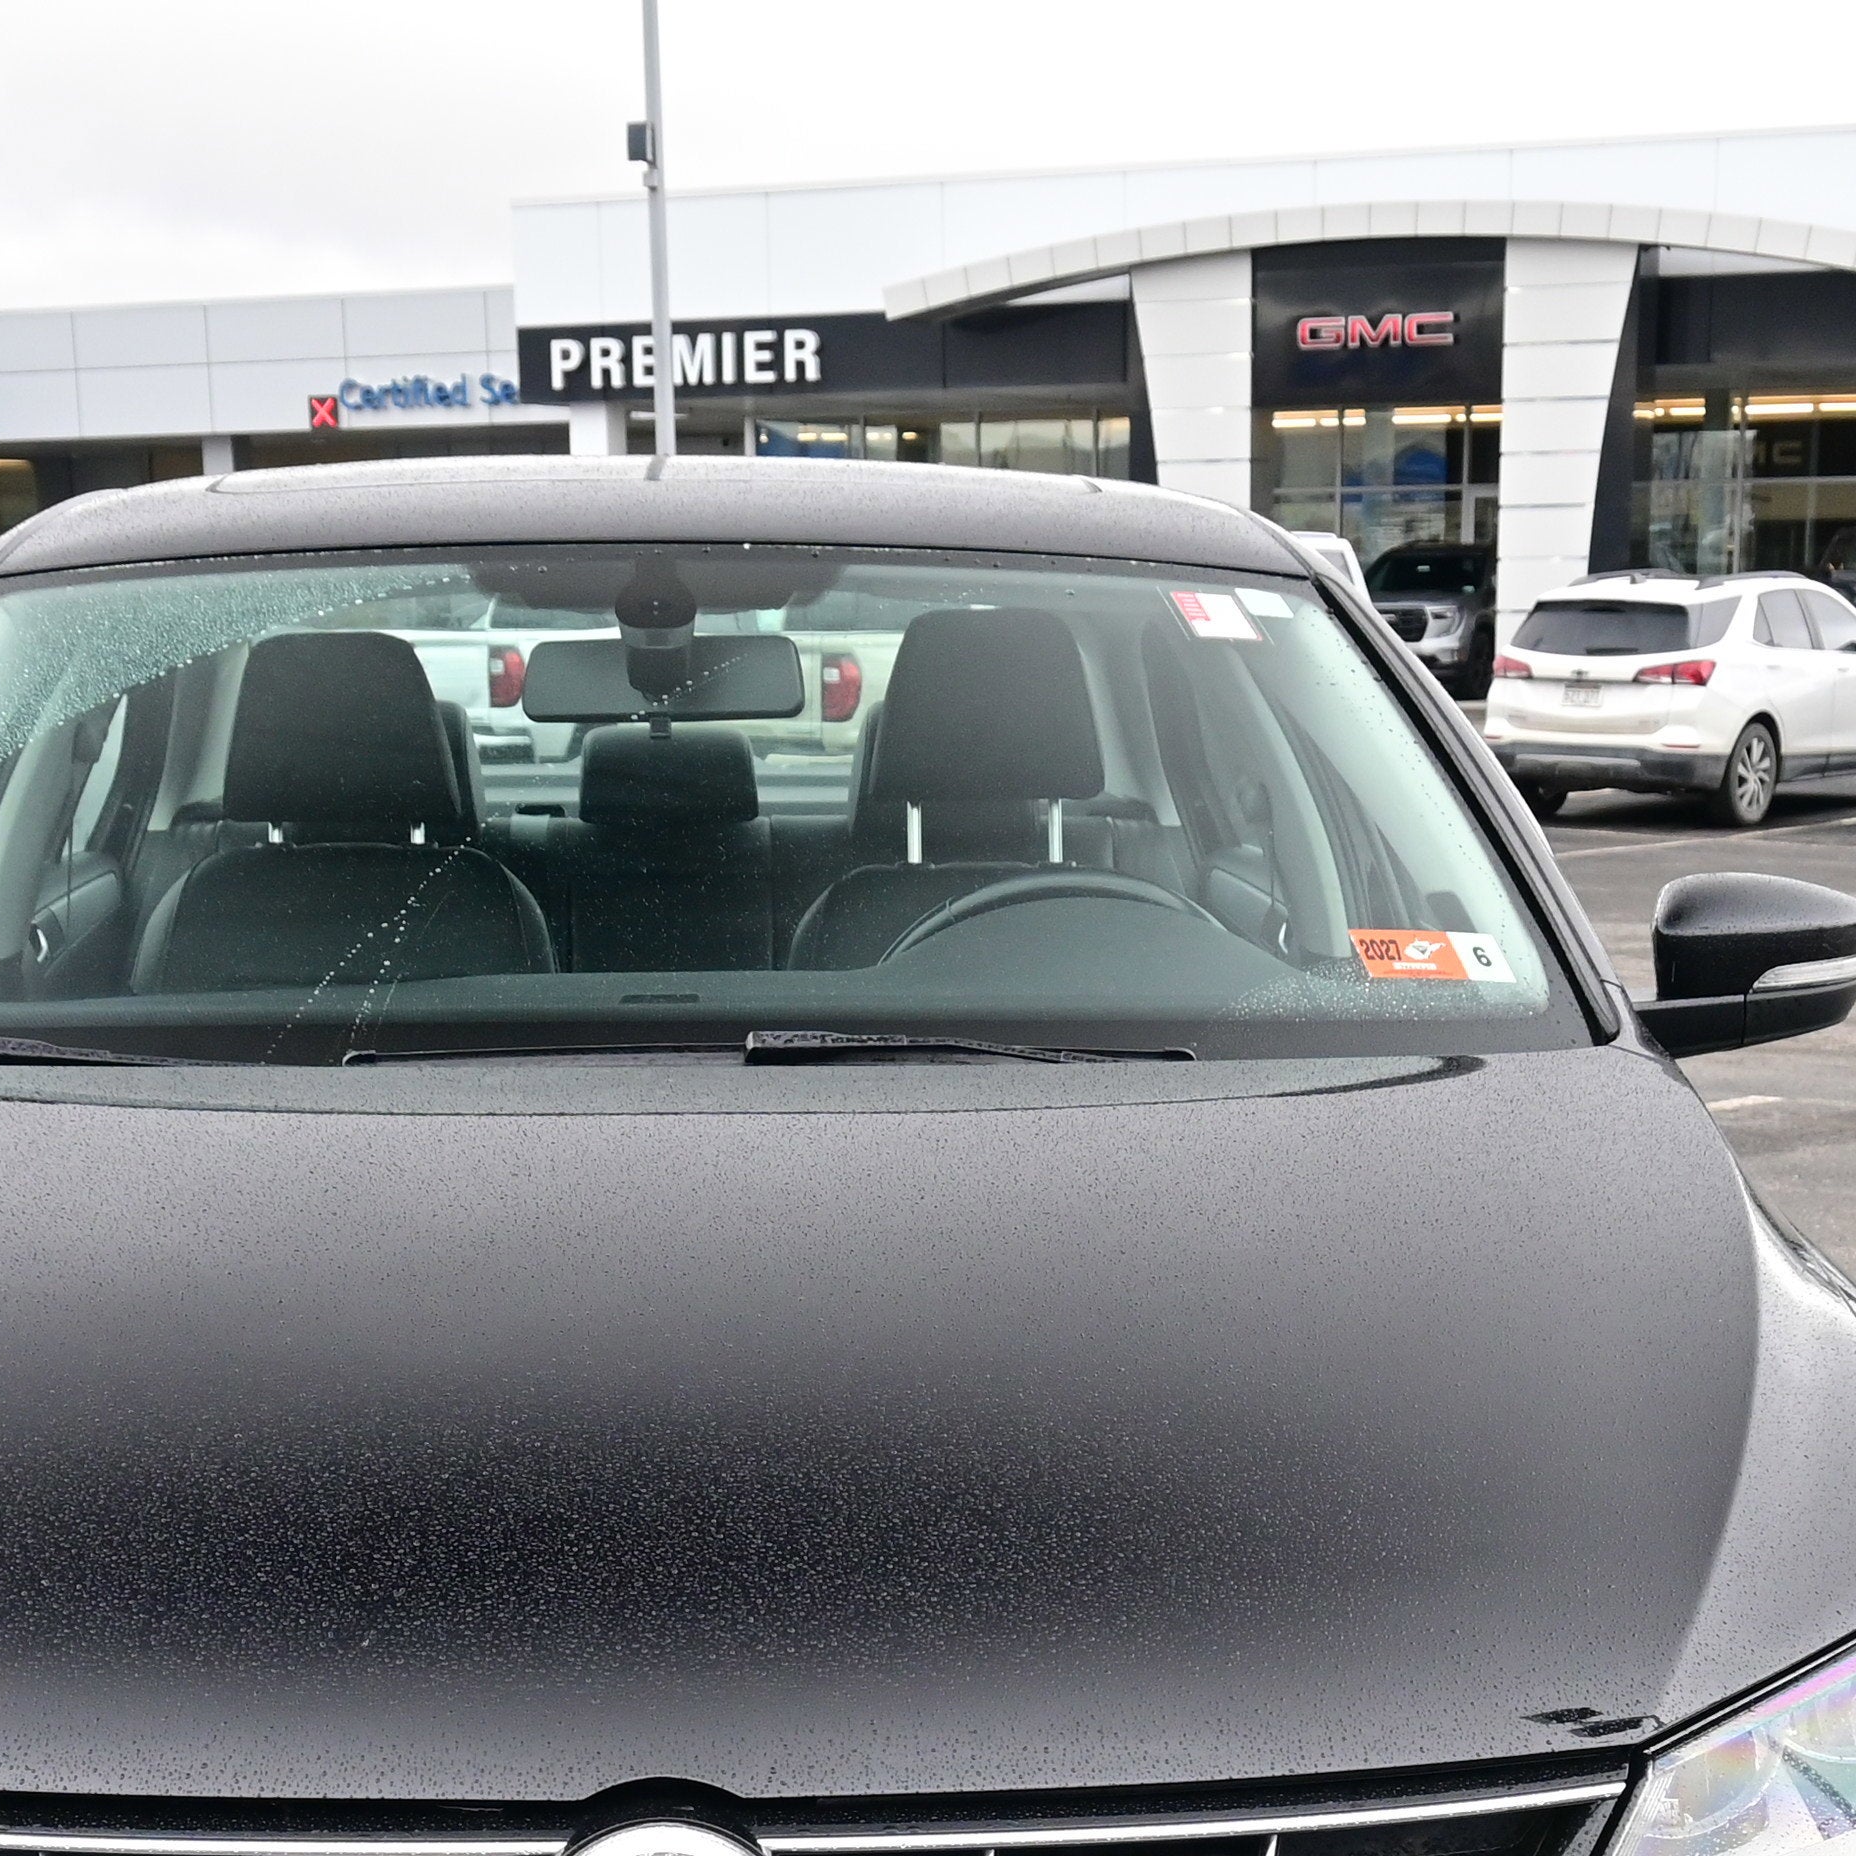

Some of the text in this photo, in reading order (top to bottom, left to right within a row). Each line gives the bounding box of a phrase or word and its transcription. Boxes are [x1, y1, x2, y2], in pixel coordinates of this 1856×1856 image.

[1297, 311, 1454, 350] GMC
[550, 328, 821, 391] PREMIER
[339, 374, 470, 410] Certified
[1359, 938, 1403, 962] 2027
[1472, 946, 1492, 967] 6
